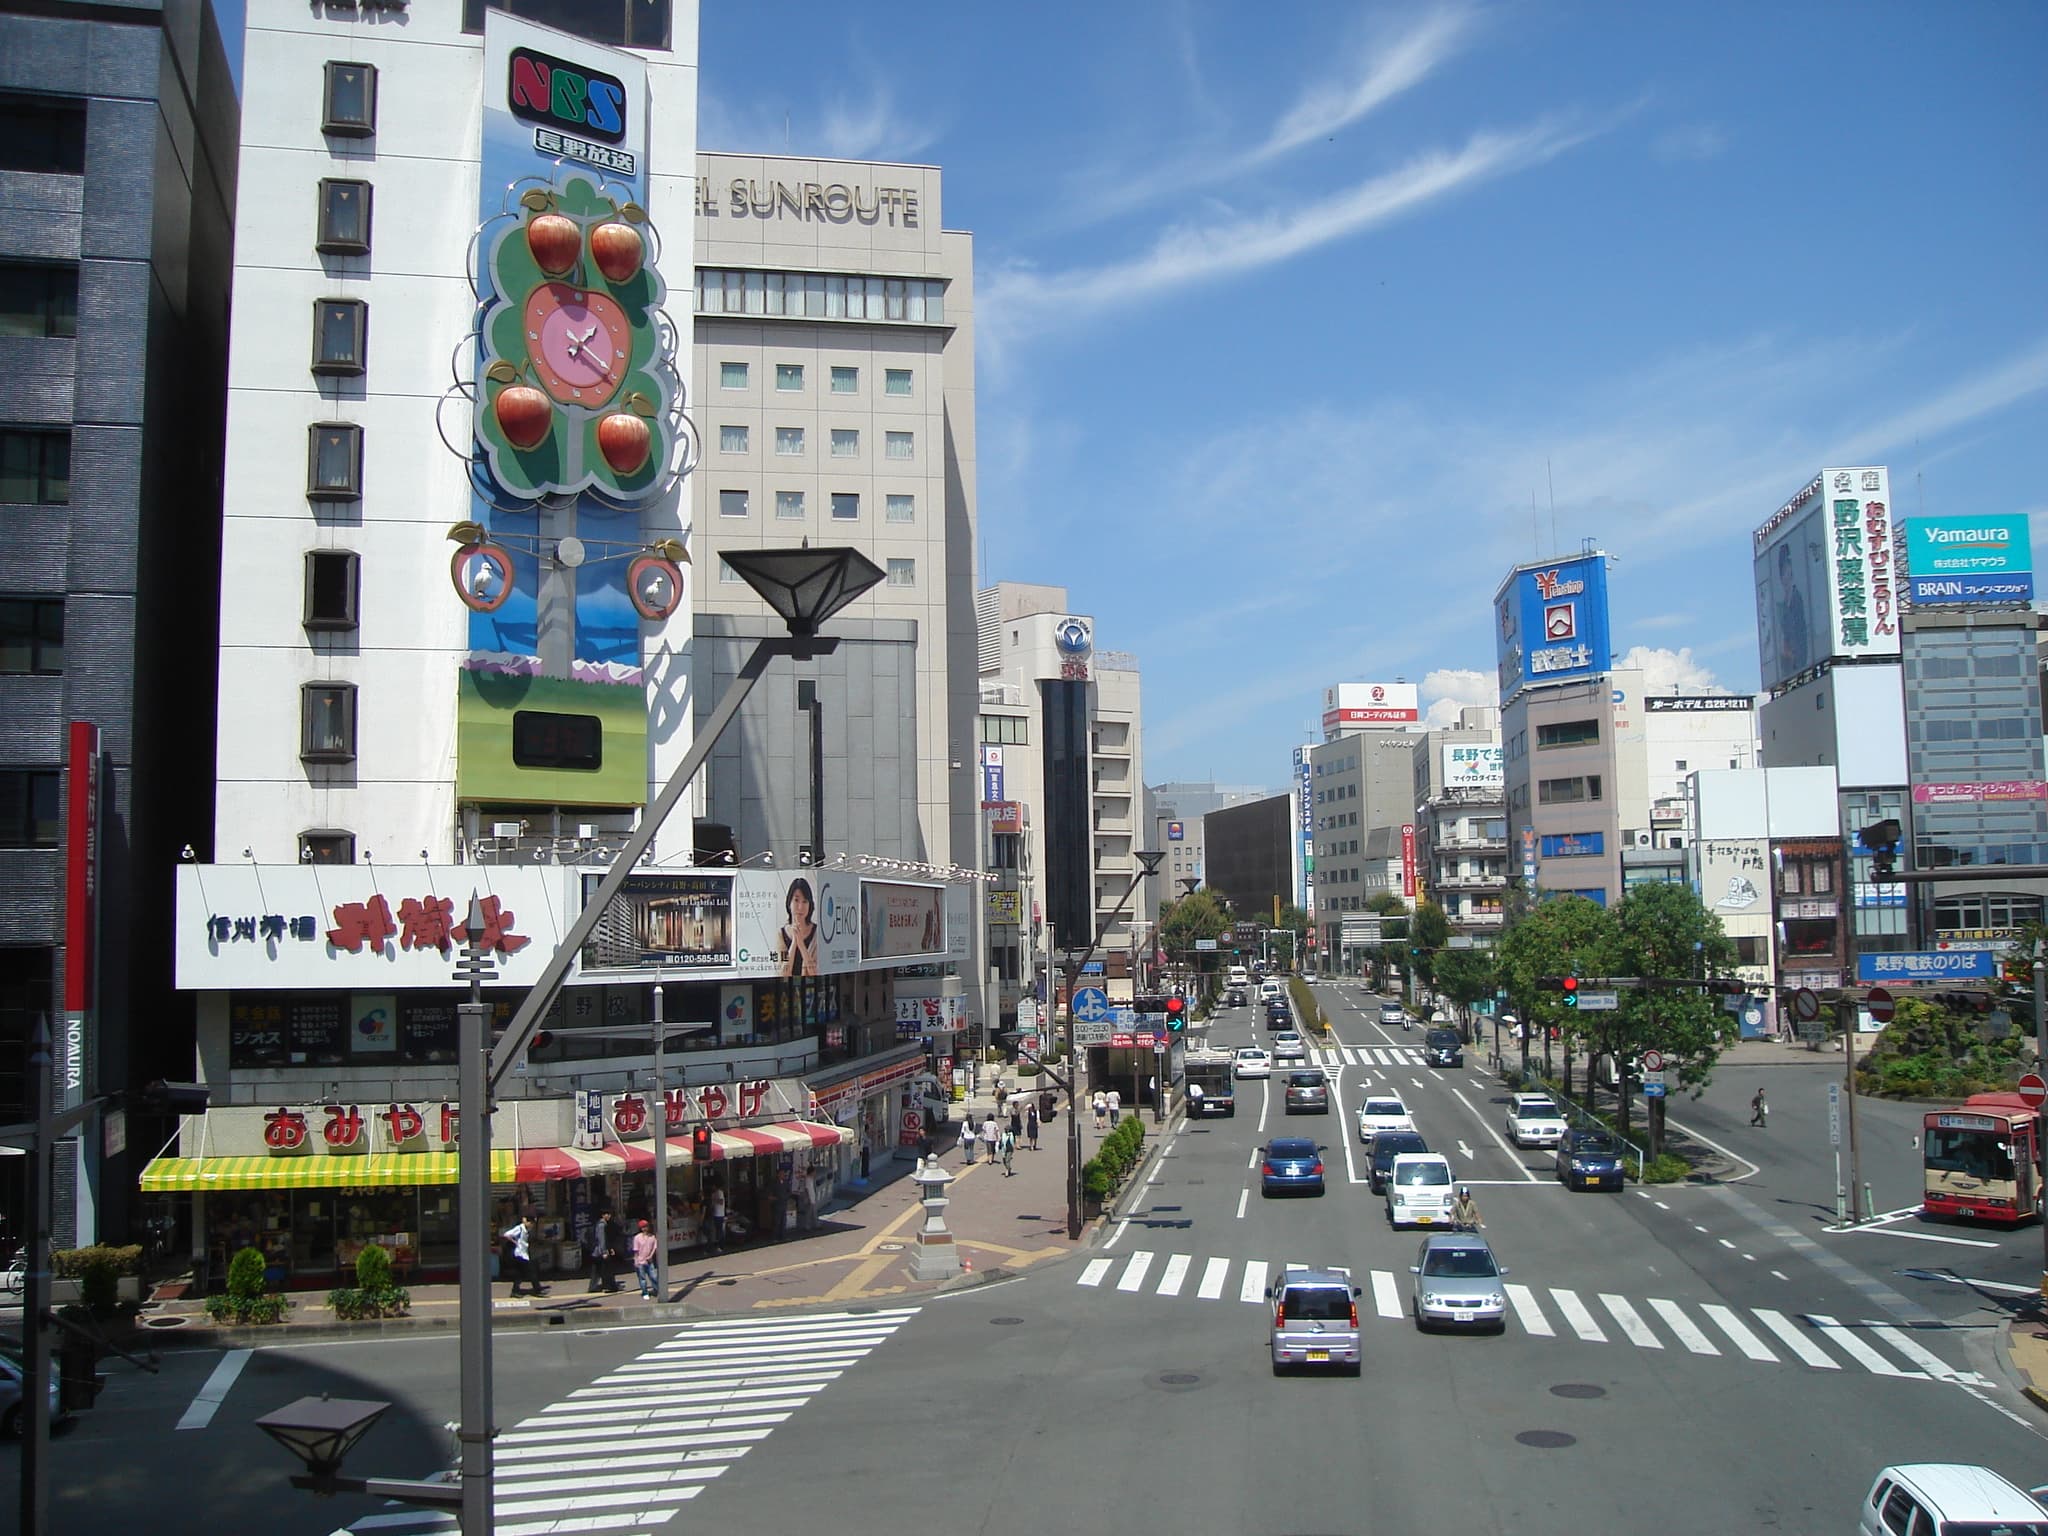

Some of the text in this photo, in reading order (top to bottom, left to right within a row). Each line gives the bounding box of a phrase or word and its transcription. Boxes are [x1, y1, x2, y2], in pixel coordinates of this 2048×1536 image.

[514, 56, 622, 134] NBS
[537, 131, 633, 172] 長野放送
[730, 178, 917, 216] SUNROUTE
[1924, 527, 2009, 543] Yamaura
[1833, 499, 1868, 646] 野沢菜茶漬
[1865, 501, 1896, 635] おむすびころりん
[1918, 582, 1962, 596] BRAIN
[1531, 644, 1593, 673] 武富士
[1874, 954, 1977, 971] 長野電鉄のりば
[67, 1019, 81, 1090] NOMURA
[233, 1030, 283, 1046] ジオス
[612, 1079, 771, 1134] おみやげ
